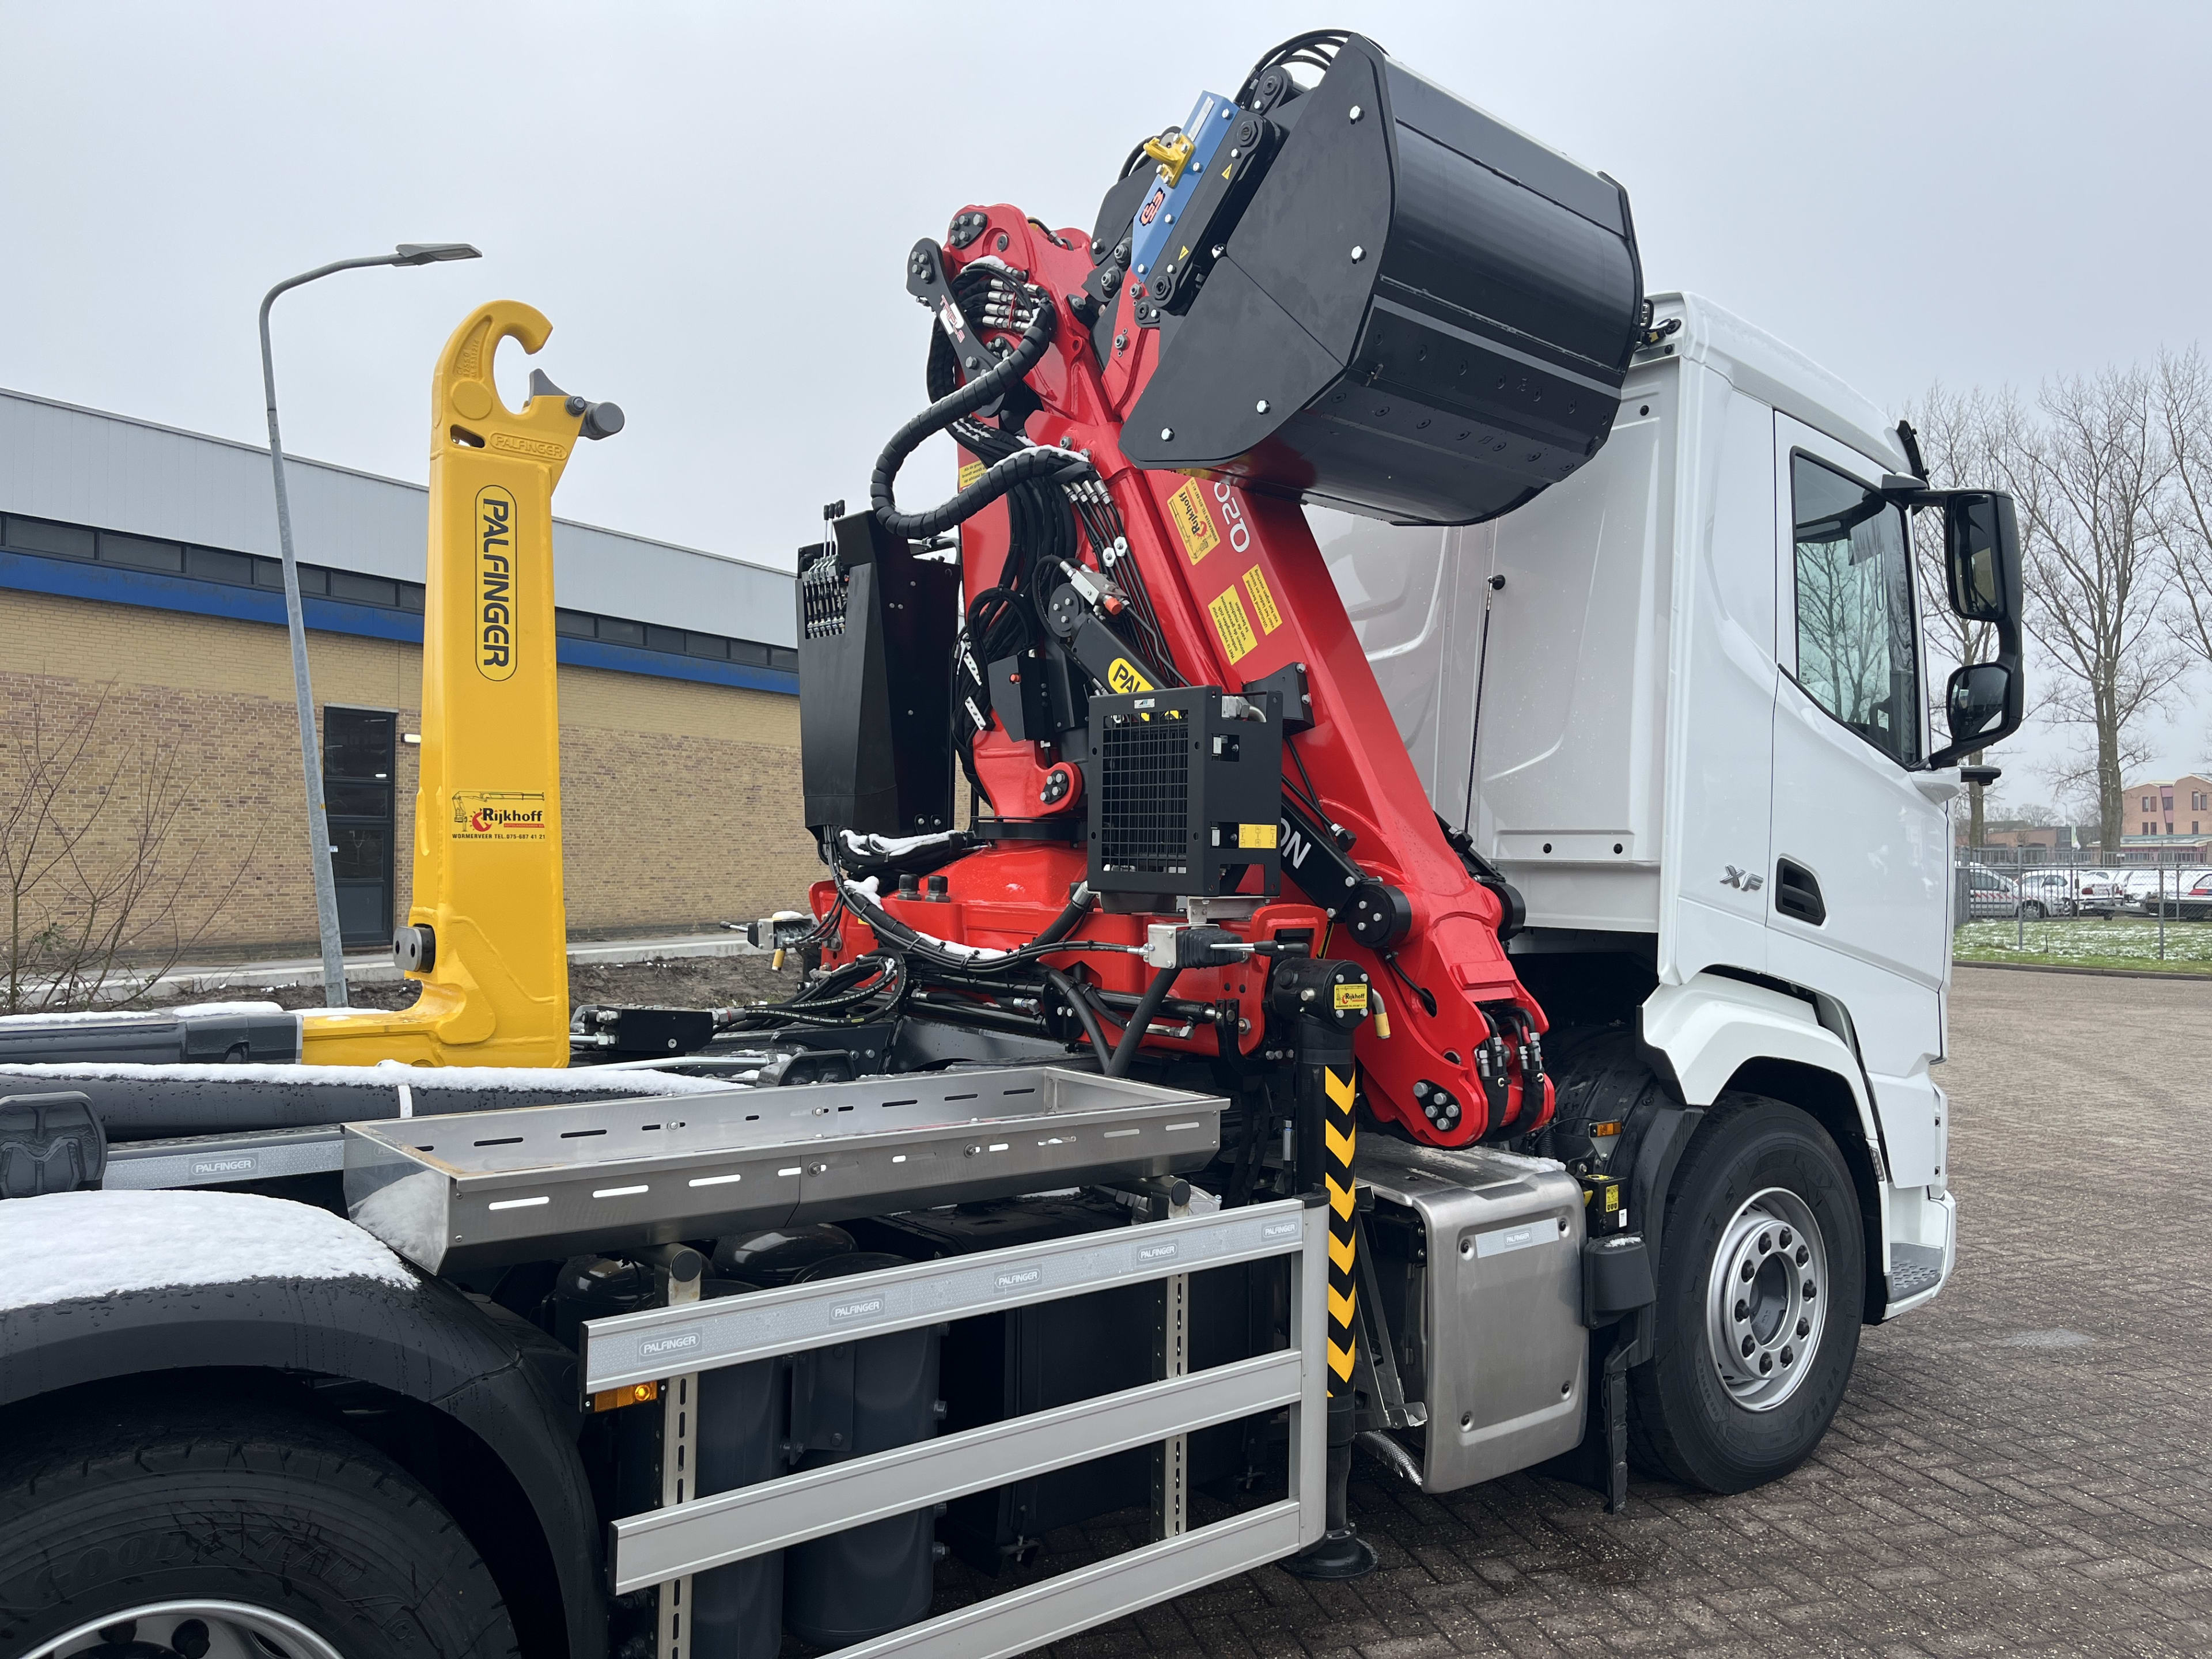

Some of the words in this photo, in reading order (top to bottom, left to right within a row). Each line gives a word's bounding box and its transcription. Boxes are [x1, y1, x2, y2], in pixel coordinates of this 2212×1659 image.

[495, 437, 562, 457] PALFINGER
[1178, 490, 1202, 535] Rijkhoff
[483, 498, 509, 667] PALFINGER
[1257, 593, 1266, 608] laden
[1228, 601, 1239, 623] machine
[1234, 601, 1247, 626] bevinden
[1216, 618, 1229, 643] verboden
[1232, 628, 1238, 636] de
[1235, 635, 1245, 654] binnen
[483, 808, 543, 824] Rijkhoff
[1719, 863, 1764, 892] XF
[1346, 993, 1365, 1001] Rijkhoff
[196, 1160, 252, 1173] PALFINGER
[1264, 1224, 1296, 1237] PALFINGER
[1506, 1232, 1530, 1244] PALFINGER
[1141, 1245, 1175, 1259] PALFINGER
[998, 1271, 1038, 1286] PALFINGER
[835, 1299, 880, 1317] PALFINGER
[643, 1335, 696, 1354] PALFINGER
[33, 1528, 367, 1596] GOODYEAR
